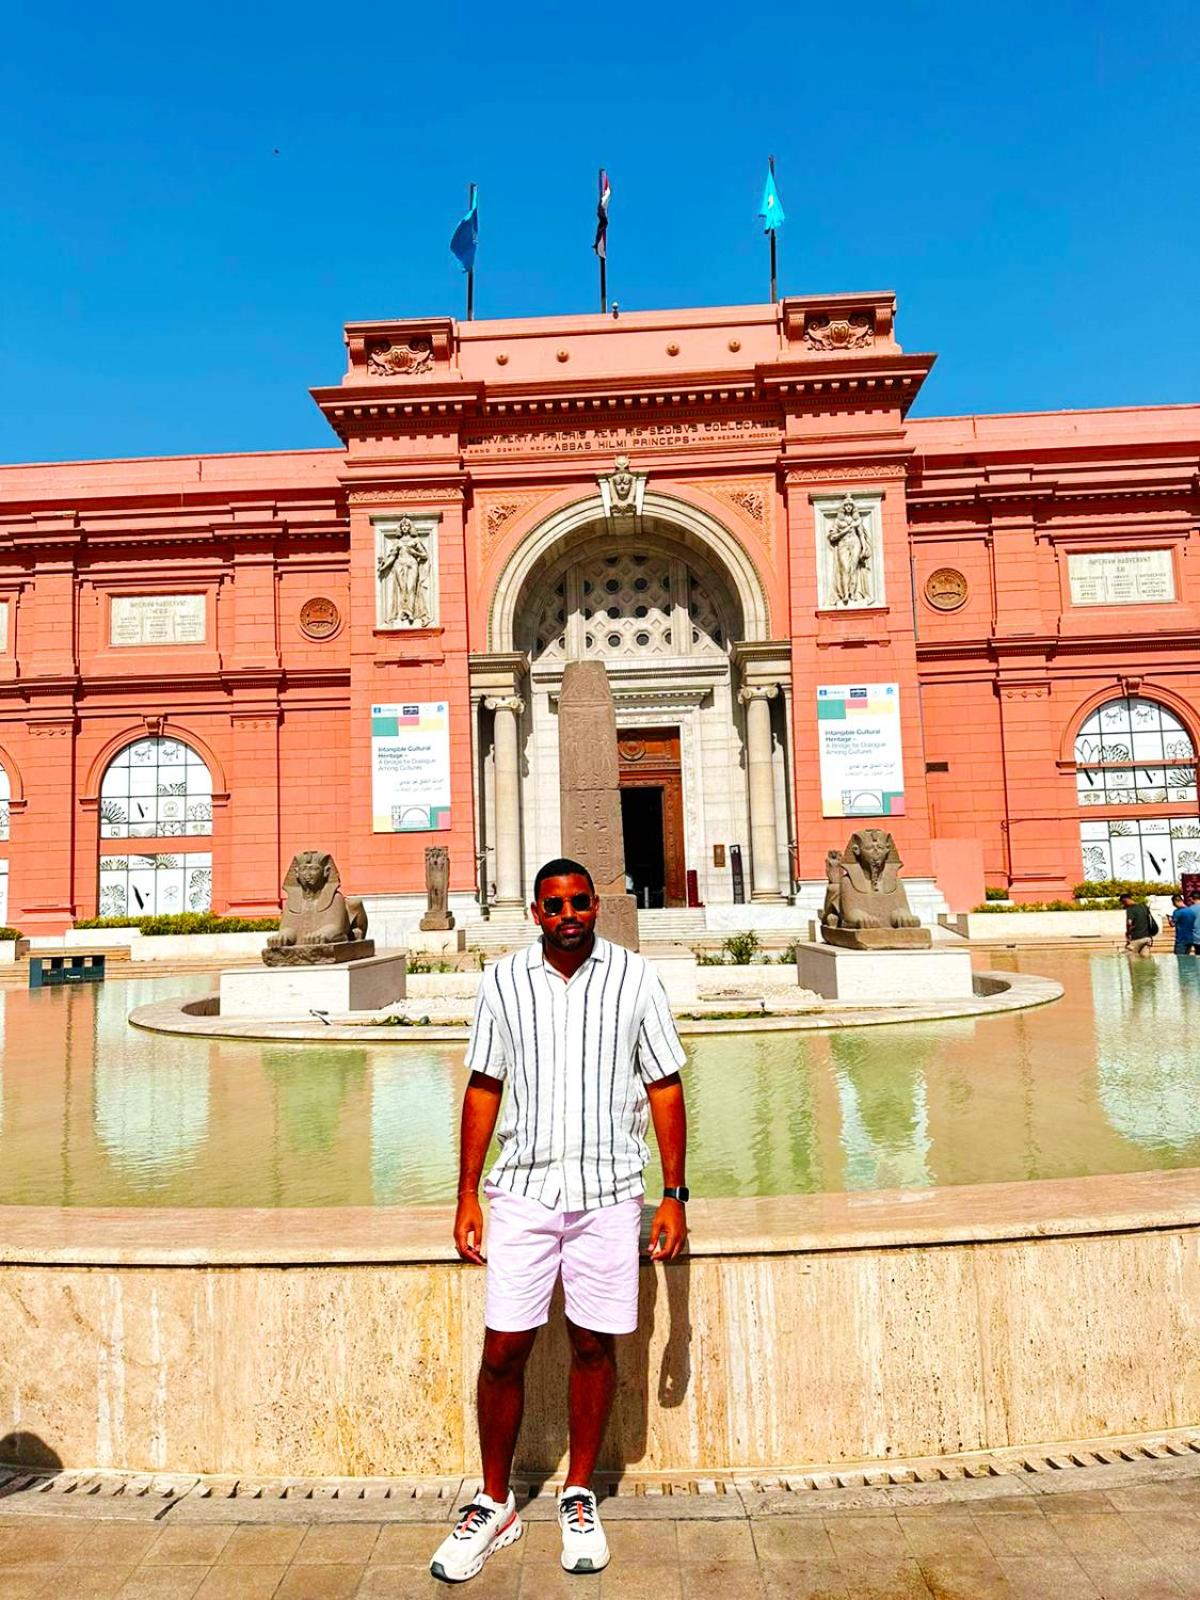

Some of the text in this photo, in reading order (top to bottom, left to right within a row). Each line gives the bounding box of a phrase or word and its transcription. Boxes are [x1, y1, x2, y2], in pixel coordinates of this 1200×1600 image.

[555, 442, 591, 451] ABBAS
[598, 439, 626, 449] HILMI
[633, 436, 689, 447] PRINCEPS
